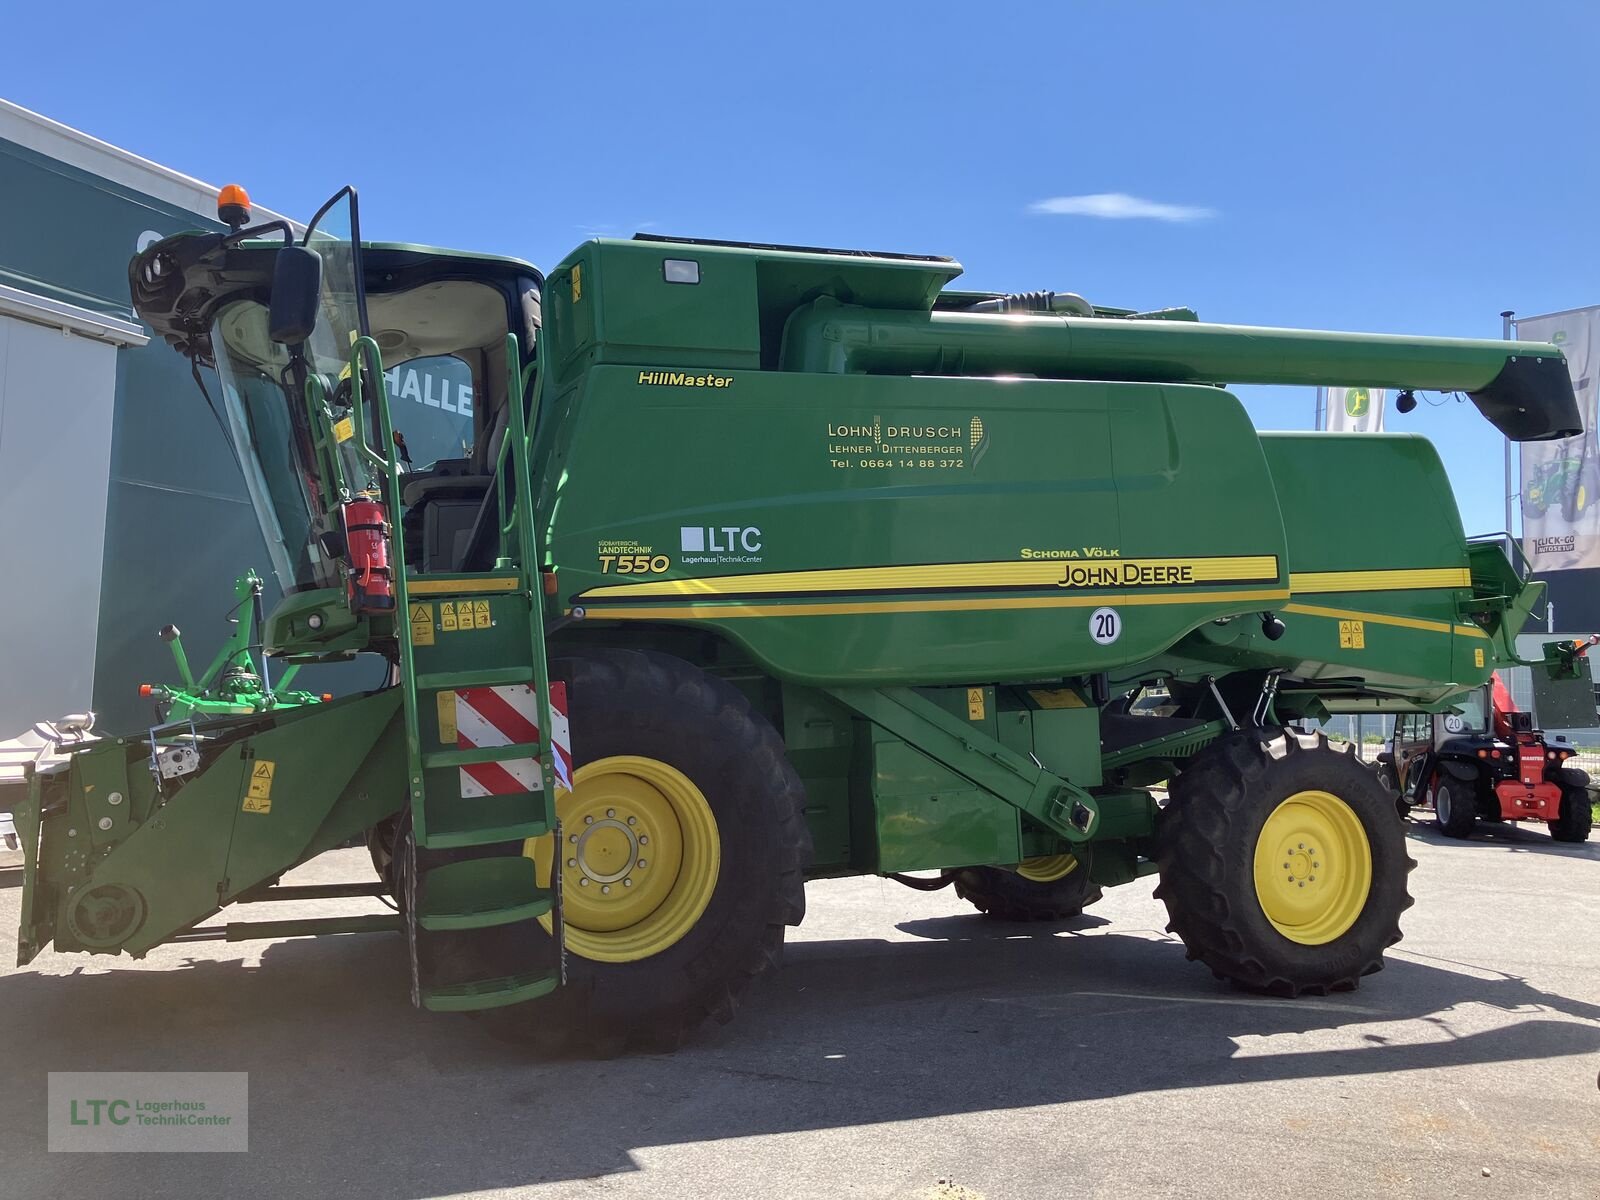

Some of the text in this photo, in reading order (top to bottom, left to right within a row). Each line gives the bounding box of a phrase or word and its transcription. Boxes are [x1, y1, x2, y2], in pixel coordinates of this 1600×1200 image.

[638, 371, 733, 388] HillMaster
[383, 365, 473, 418] HALLE
[828, 423, 961, 438] LOHN DRUSCH
[829, 444, 963, 454] LEHNER DITTENBERGER
[830, 459, 964, 468] Tel. 0664 14 88 372
[708, 526, 762, 553] LTC
[598, 546, 653, 554] LANDTECHNIK
[1020, 547, 1120, 559] SCHOMA VÖLK
[598, 554, 671, 575] T550
[681, 556, 717, 564] Lagerhaus
[1058, 563, 1194, 586] JOHN DEERE
[1095, 613, 1116, 639] 20
[1448, 717, 1461, 729] 20
